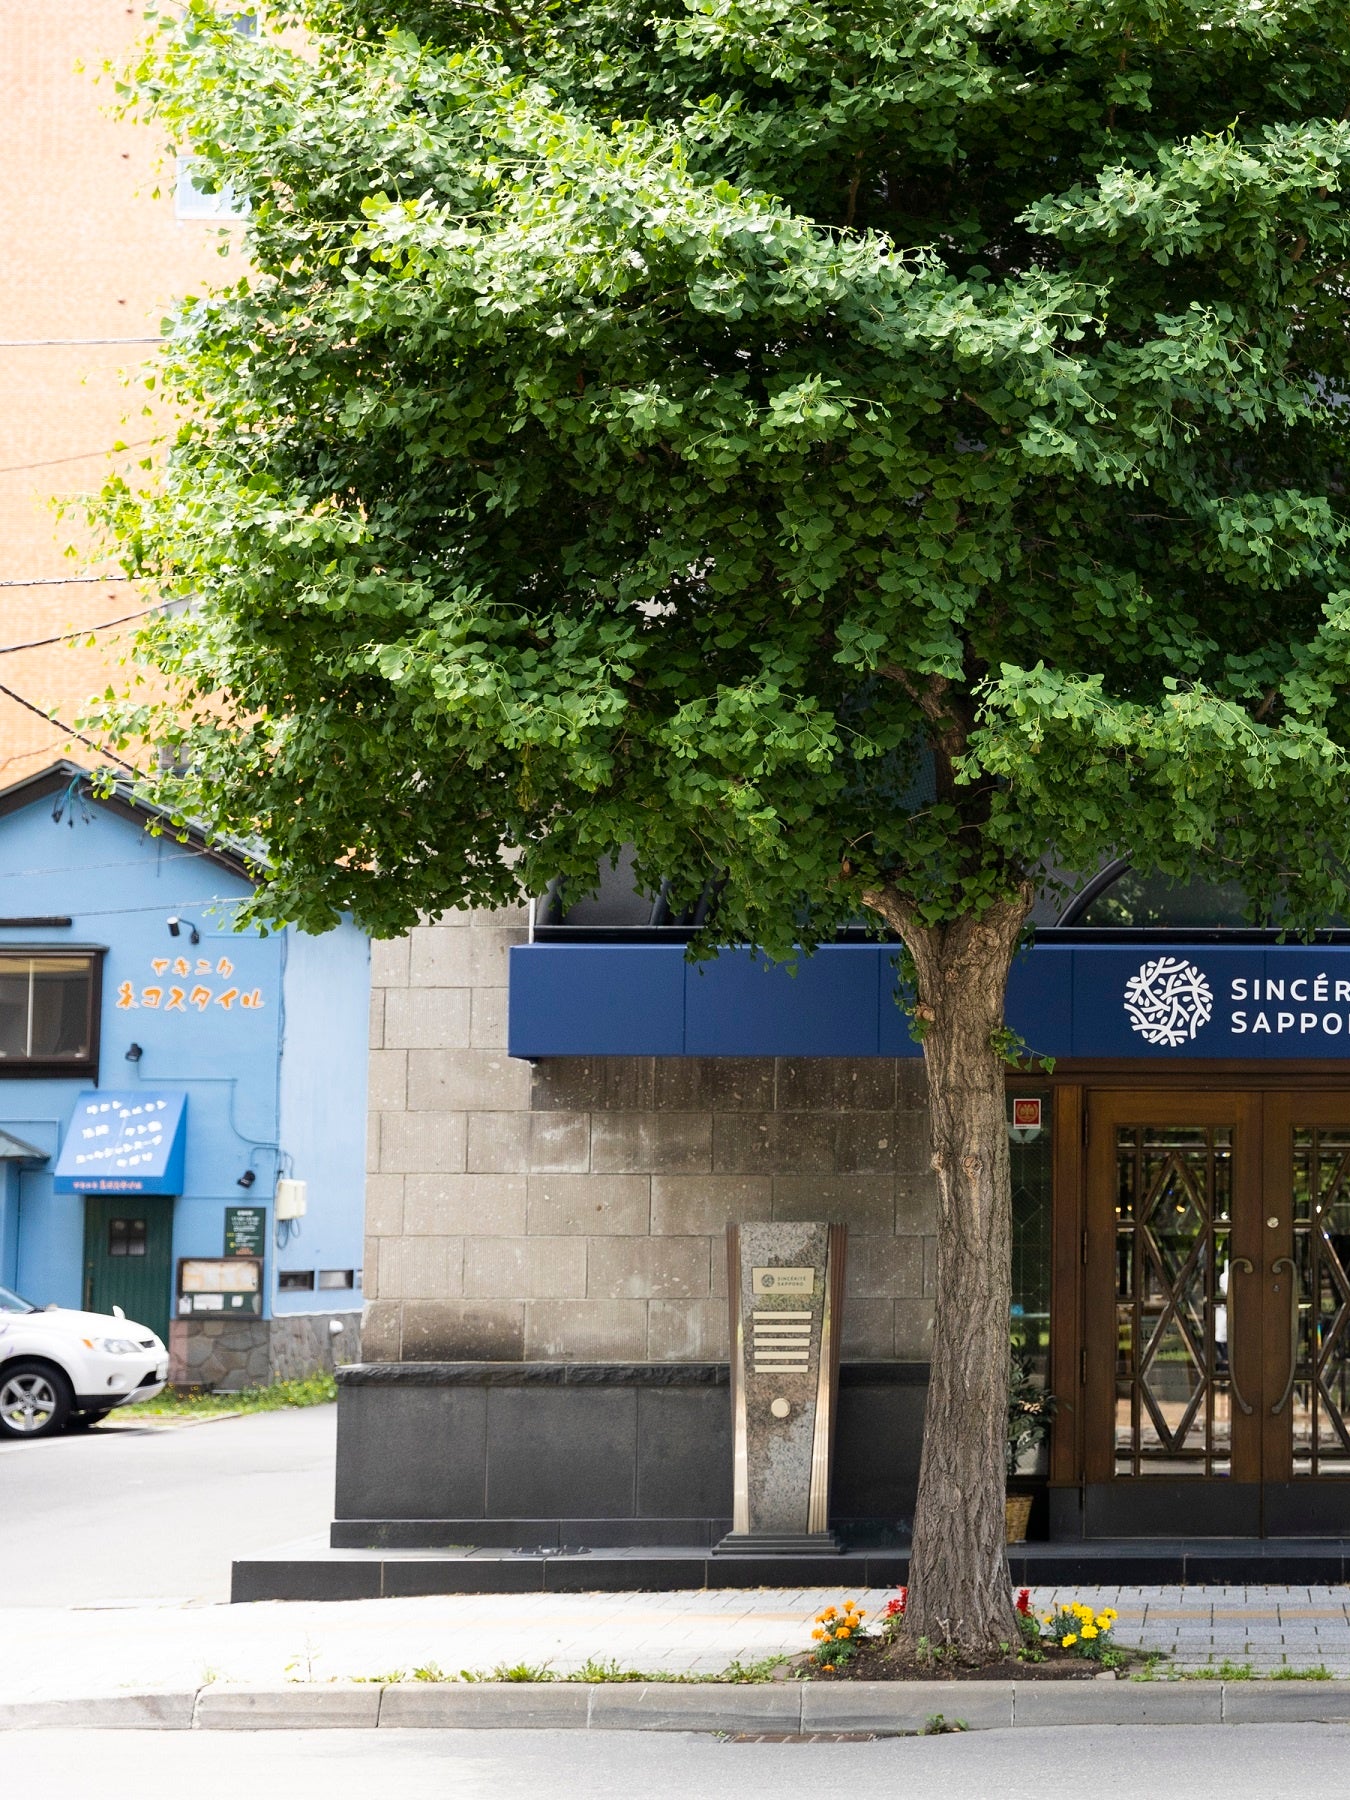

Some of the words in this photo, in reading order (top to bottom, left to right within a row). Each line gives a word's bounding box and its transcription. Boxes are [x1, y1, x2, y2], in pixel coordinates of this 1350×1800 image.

[116, 980, 264, 1012] ネコスタイル
